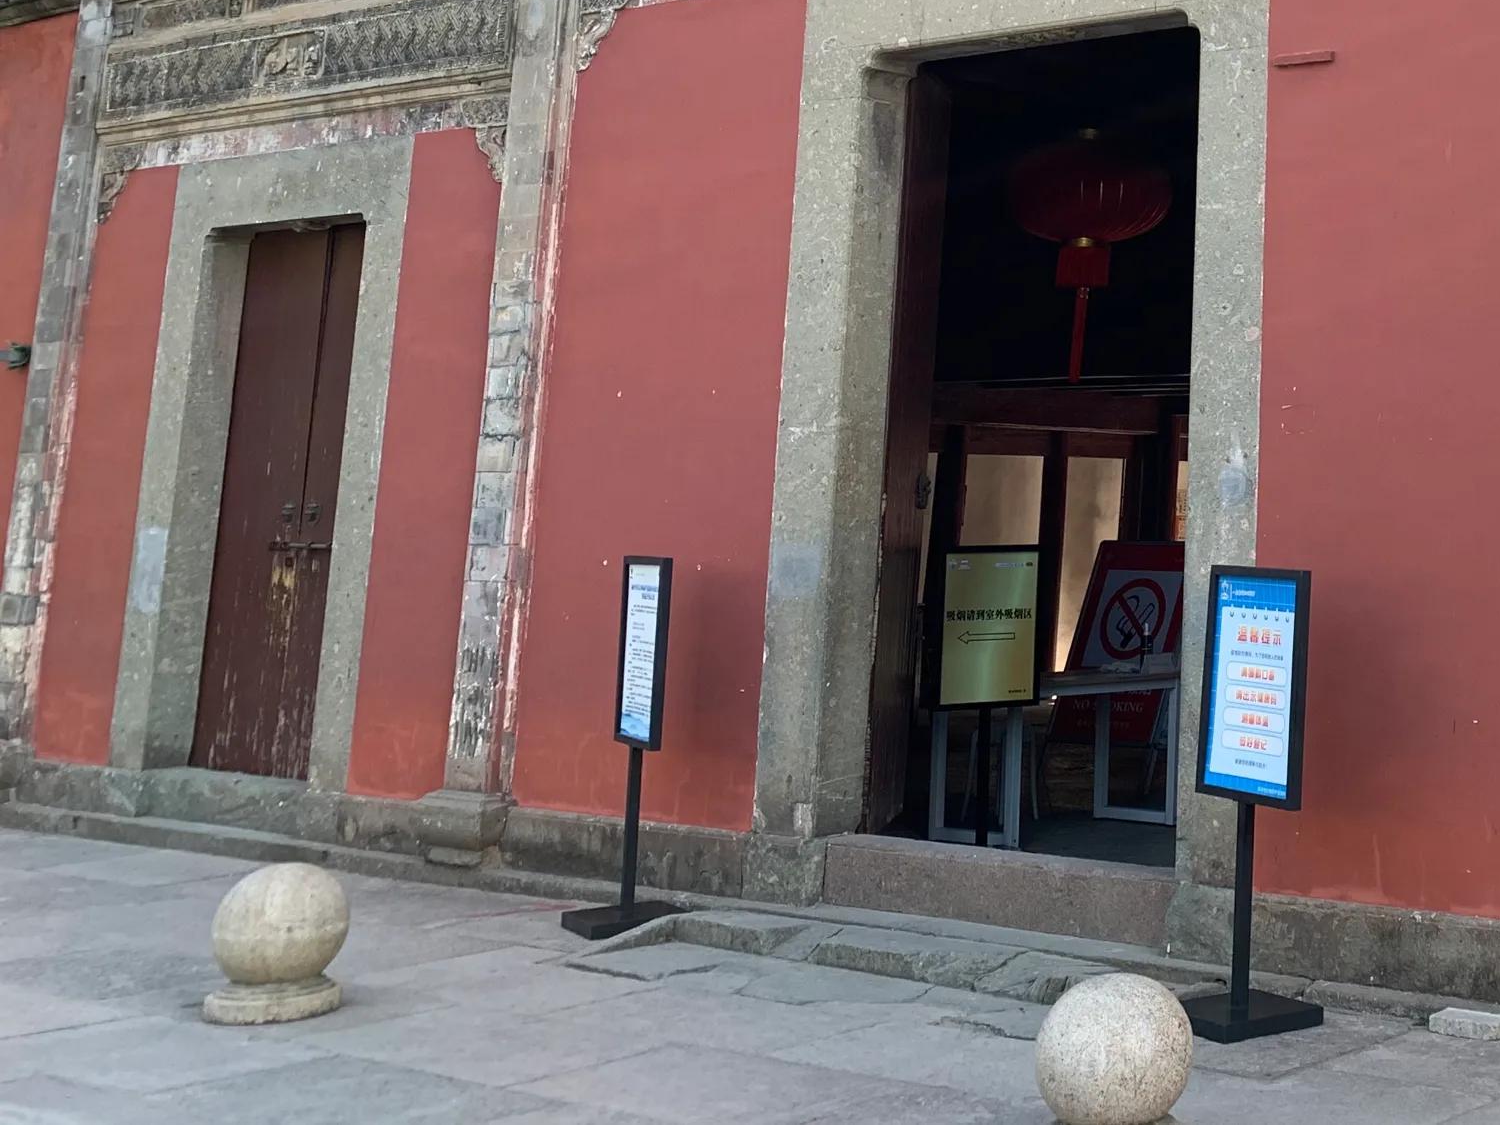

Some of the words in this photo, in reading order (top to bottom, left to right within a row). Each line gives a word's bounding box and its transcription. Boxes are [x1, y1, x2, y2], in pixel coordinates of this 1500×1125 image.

[946, 608, 1033, 621] 吸烟请到室外吸烟区
[1237, 625, 1282, 646] 温馨提示
[1092, 699, 1144, 713] SOKING
